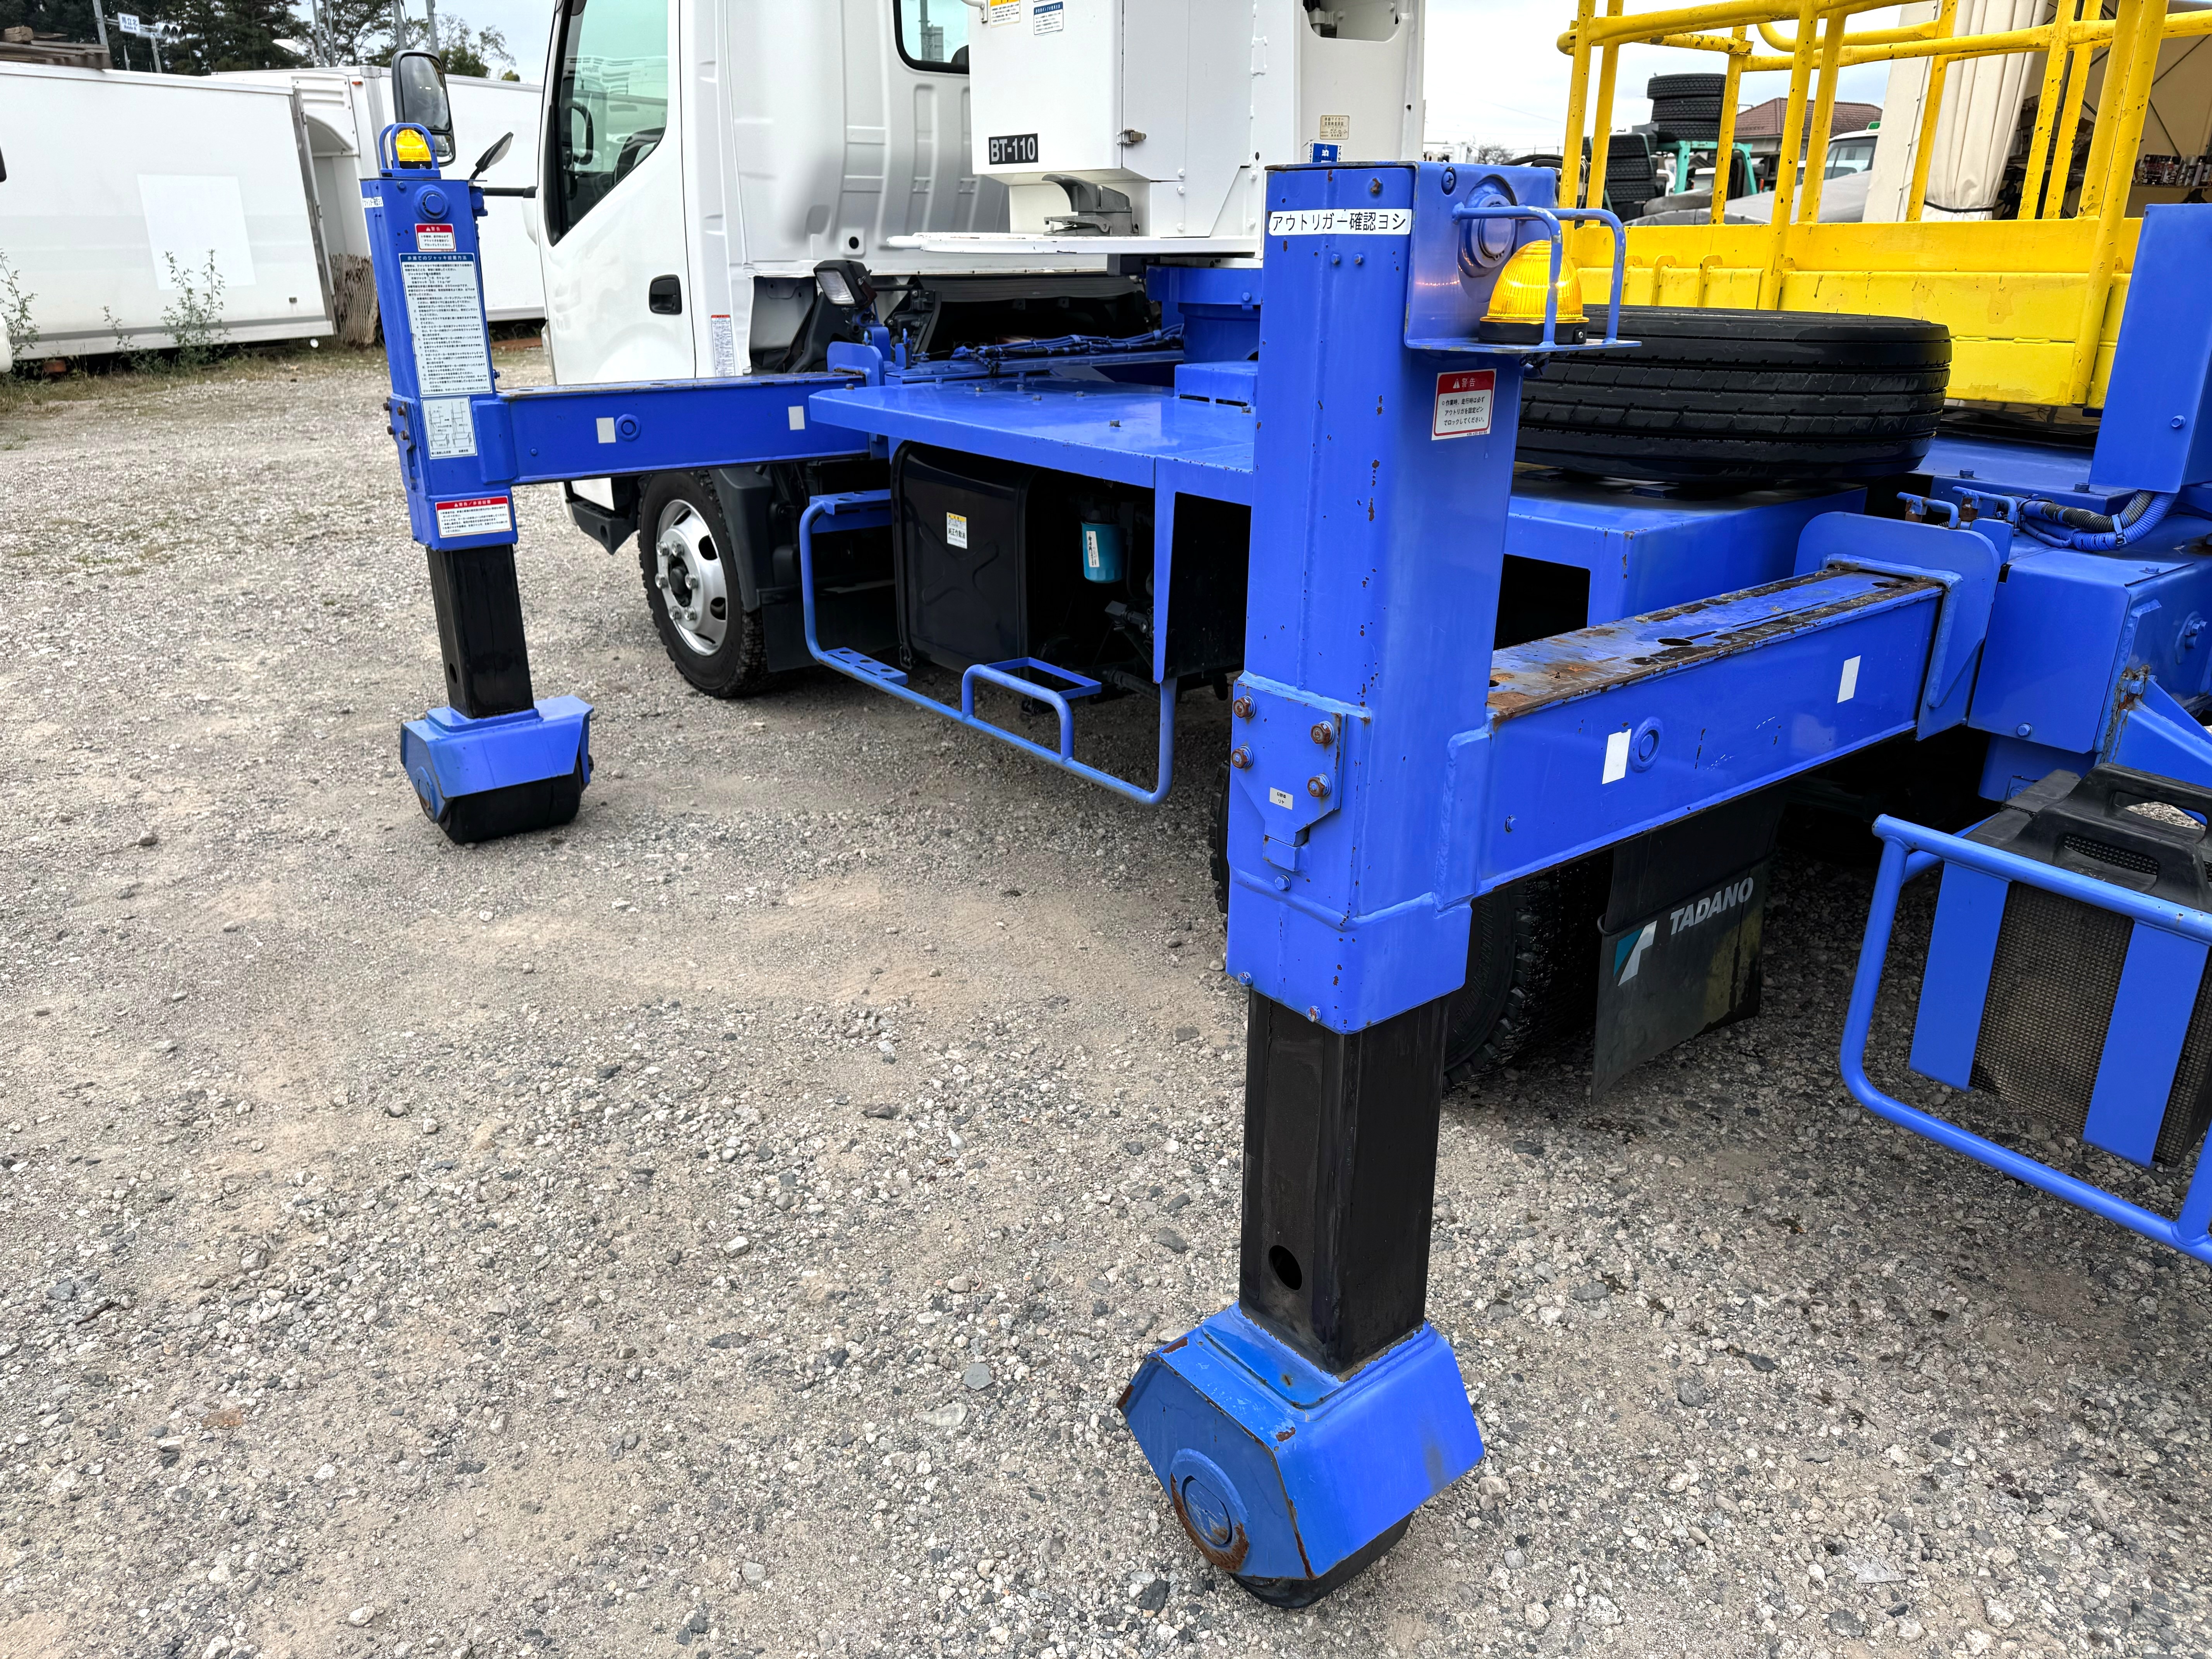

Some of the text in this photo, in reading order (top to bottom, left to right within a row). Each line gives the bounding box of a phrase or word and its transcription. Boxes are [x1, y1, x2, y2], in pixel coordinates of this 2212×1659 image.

[991, 137, 1035, 161] BT-110
[1273, 212, 1406, 231] アウトリガー確認ヨシ
[1462, 377, 1475, 387] 警告
[1445, 407, 1484, 416] アウトリガを固定ピン
[1444, 417, 1484, 426] でロックしてください。
[1670, 877, 1753, 935] TADANO
